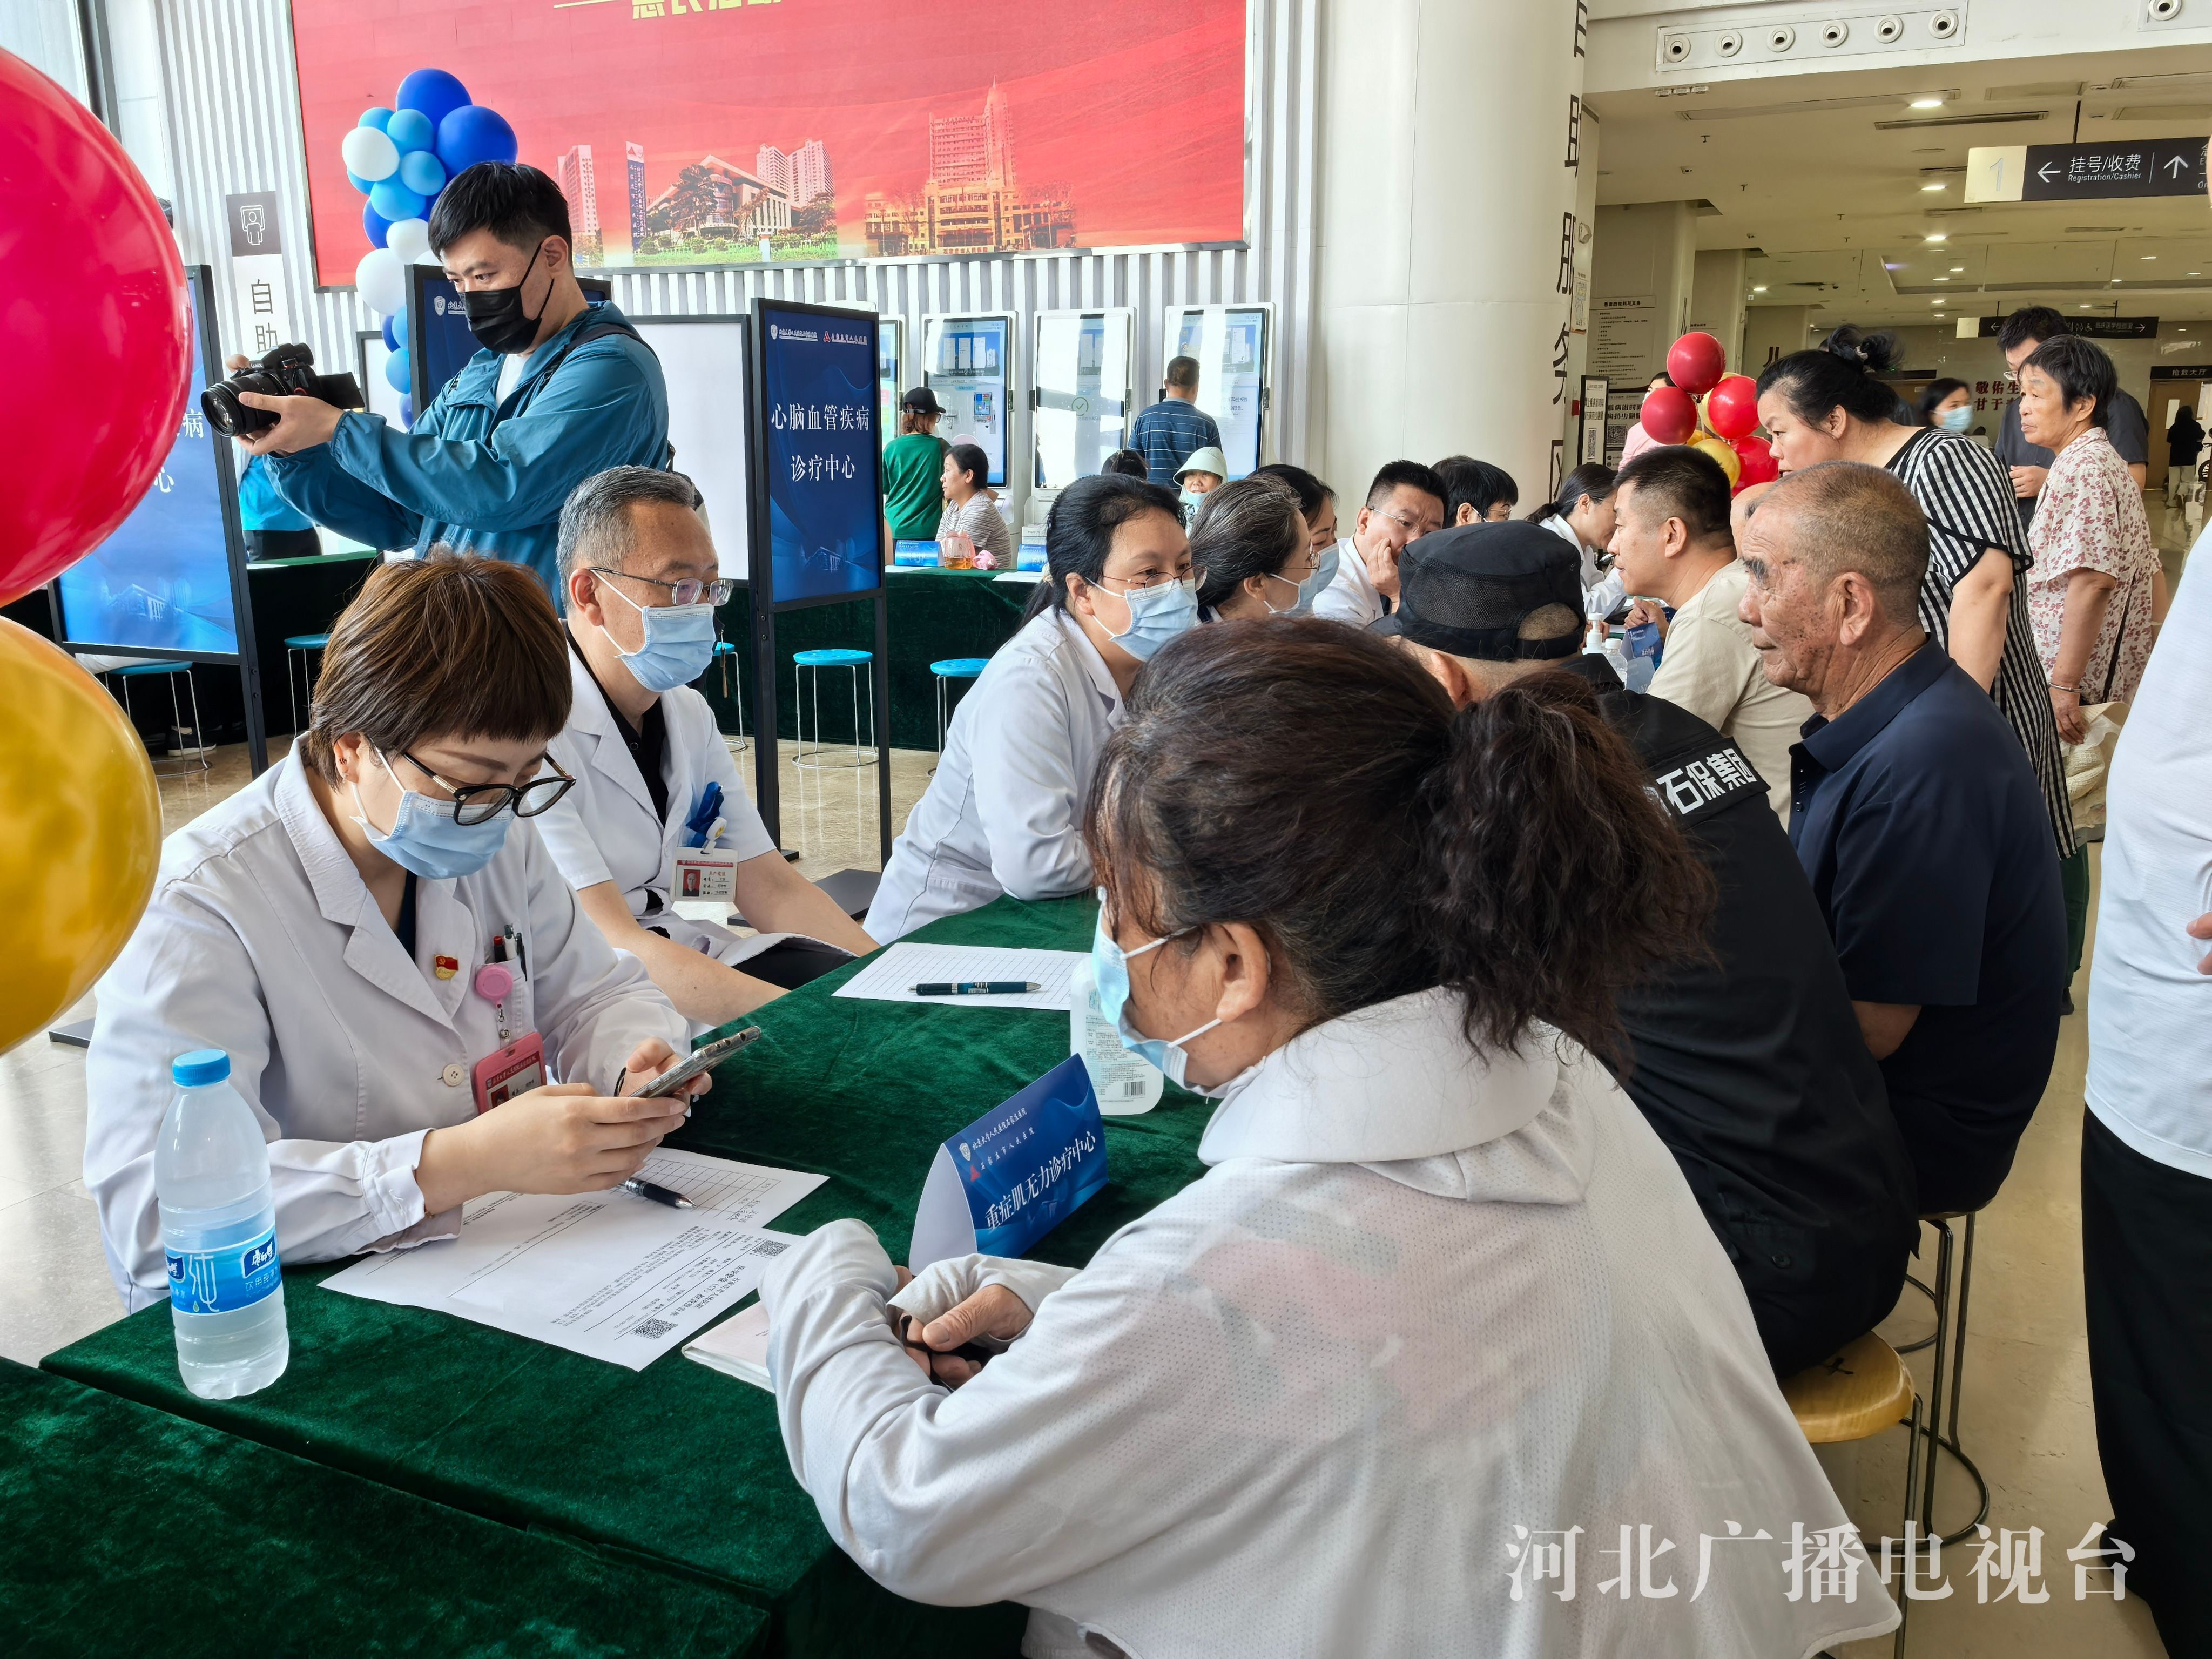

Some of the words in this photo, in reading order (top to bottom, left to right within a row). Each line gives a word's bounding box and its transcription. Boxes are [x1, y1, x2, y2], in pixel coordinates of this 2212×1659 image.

[1989, 157, 2004, 191] 1
[2068, 154, 2141, 173] 挂号/收费
[2068, 172, 2142, 183] Registration/Cashier
[771, 403, 869, 431] 心脑血管疾病
[1974, 397, 2017, 411] 甘于
[177, 408, 205, 439] 病
[791, 454, 855, 482] 诊疗中心
[985, 1131, 1096, 1230] 重症肌无力诊疗中心
[252, 1241, 274, 1266] 康师傅
